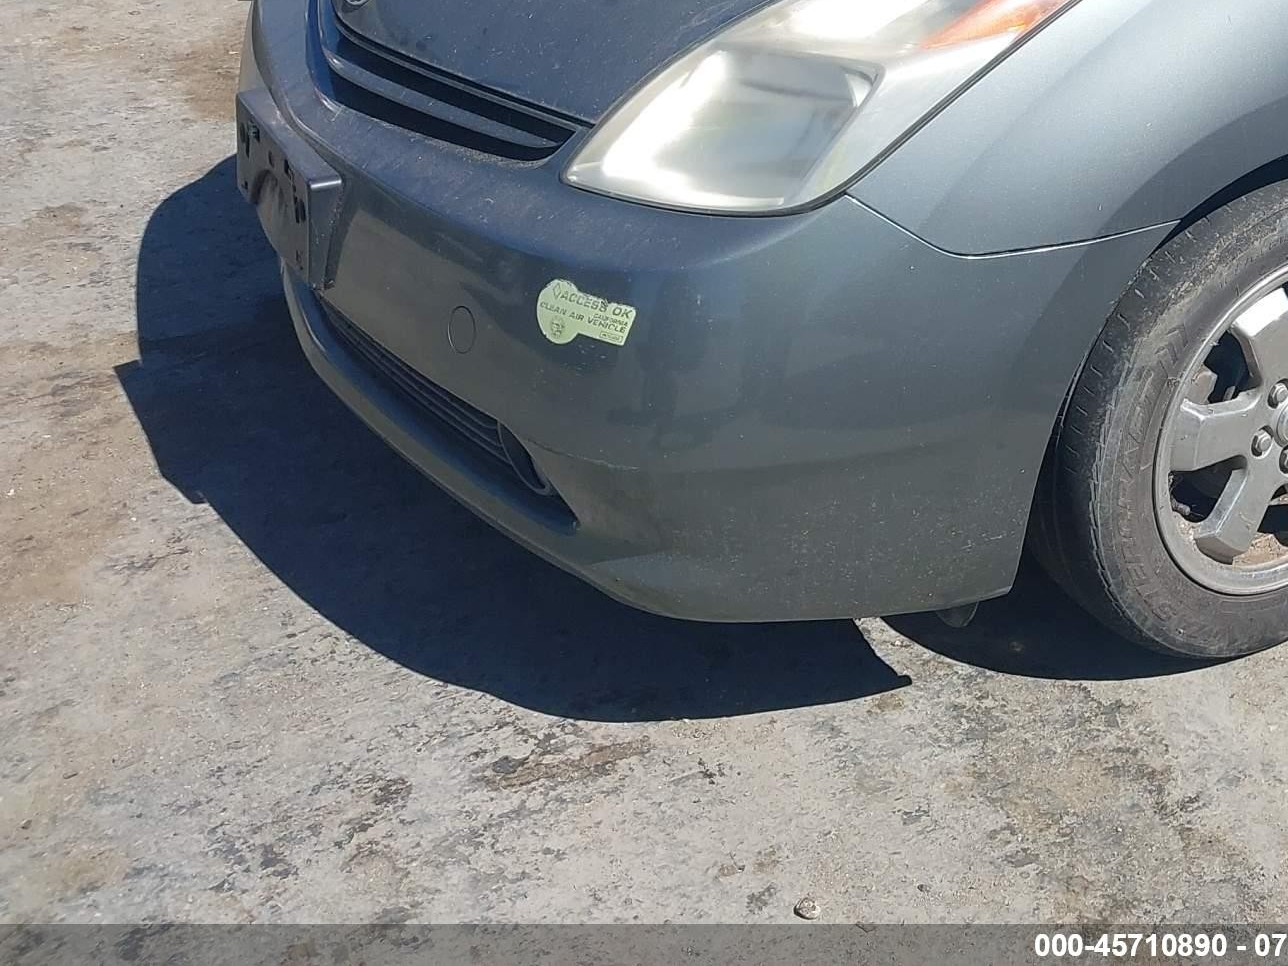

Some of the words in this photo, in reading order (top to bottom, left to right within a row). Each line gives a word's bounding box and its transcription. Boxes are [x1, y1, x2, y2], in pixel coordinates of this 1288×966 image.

[539, 301, 567, 317] CLEAN
[568, 311, 585, 322] AIR
[587, 317, 627, 334] VEHICLE
[560, 290, 608, 313] ACCESS
[612, 306, 633, 320] OK
[593, 313, 629, 328] CALIFORNIA
